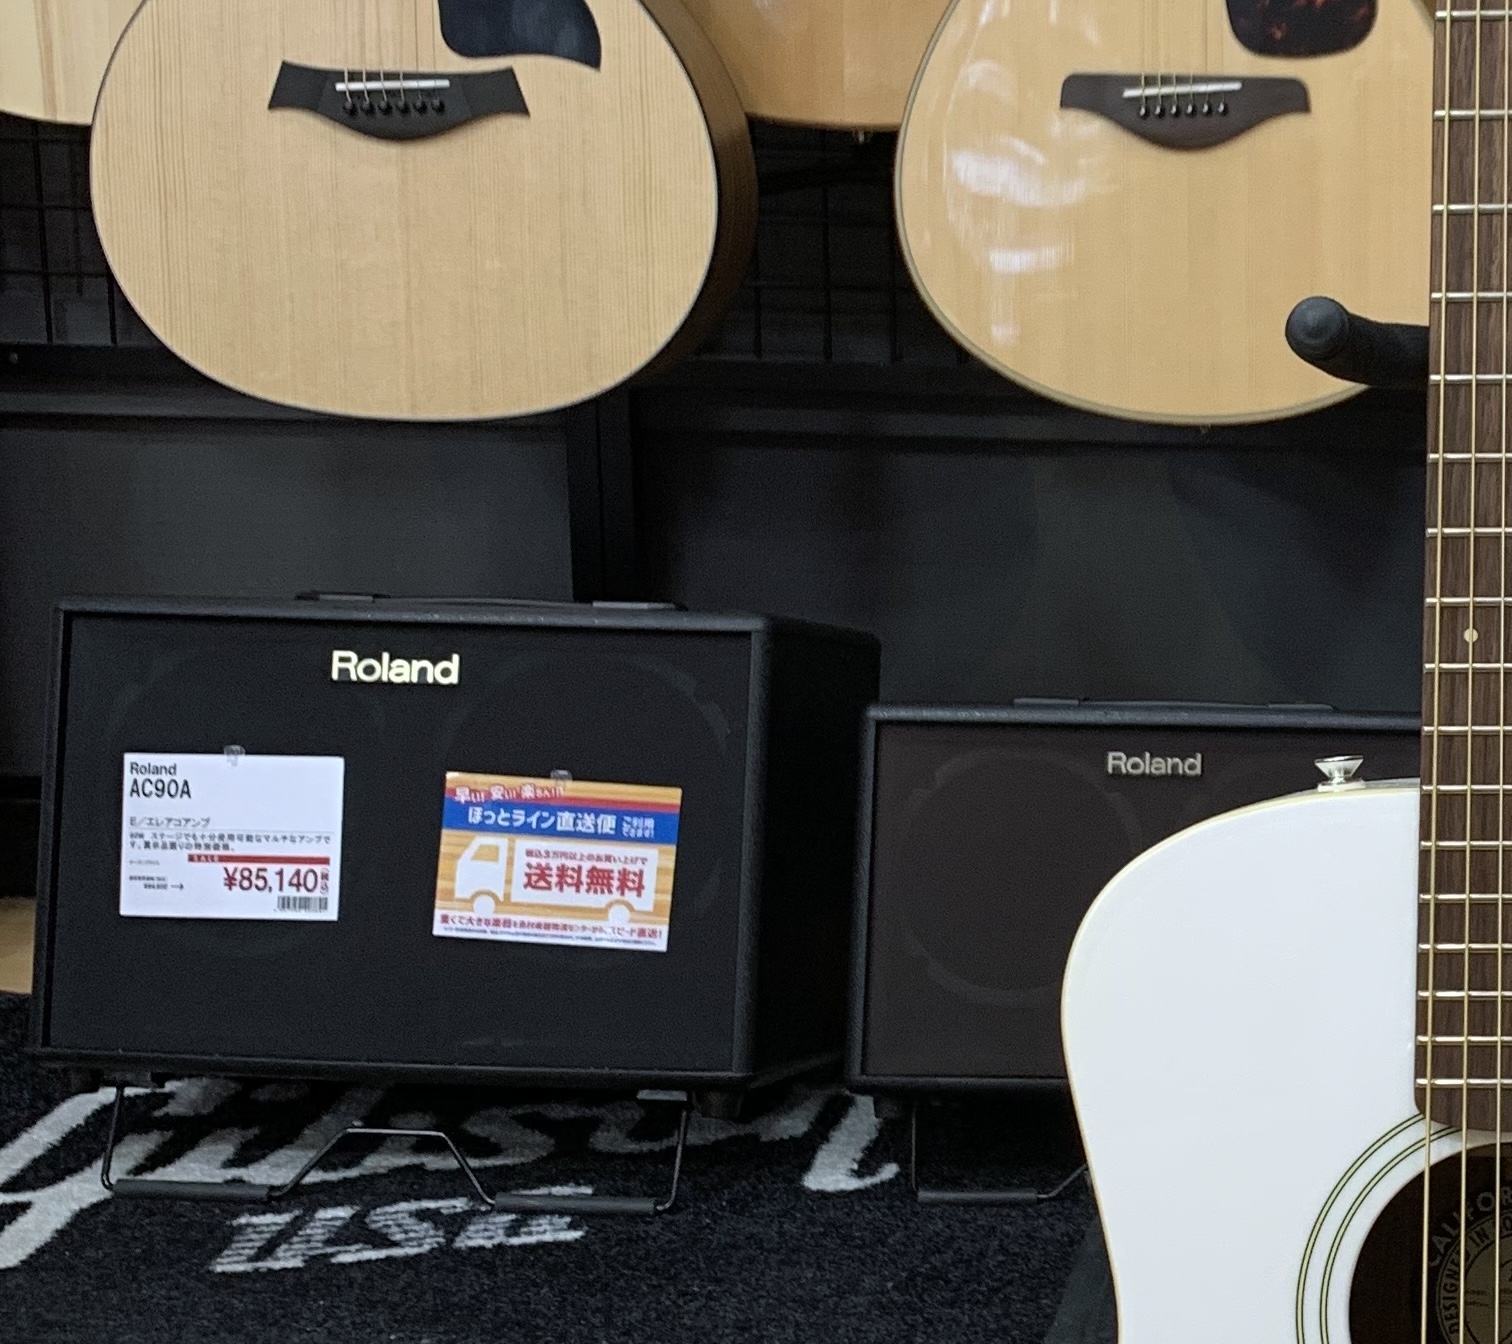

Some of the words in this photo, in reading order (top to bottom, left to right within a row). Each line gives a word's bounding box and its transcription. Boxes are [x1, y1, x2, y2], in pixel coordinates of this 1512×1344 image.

[331, 649, 460, 685] Roland
[129, 762, 177, 776] Roland
[1106, 751, 1203, 776] Roland
[130, 778, 191, 799] AC90A
[468, 805, 617, 836] ほっとライン直送便
[224, 866, 318, 894] ¥85,140
[522, 861, 646, 898] 送料無料
